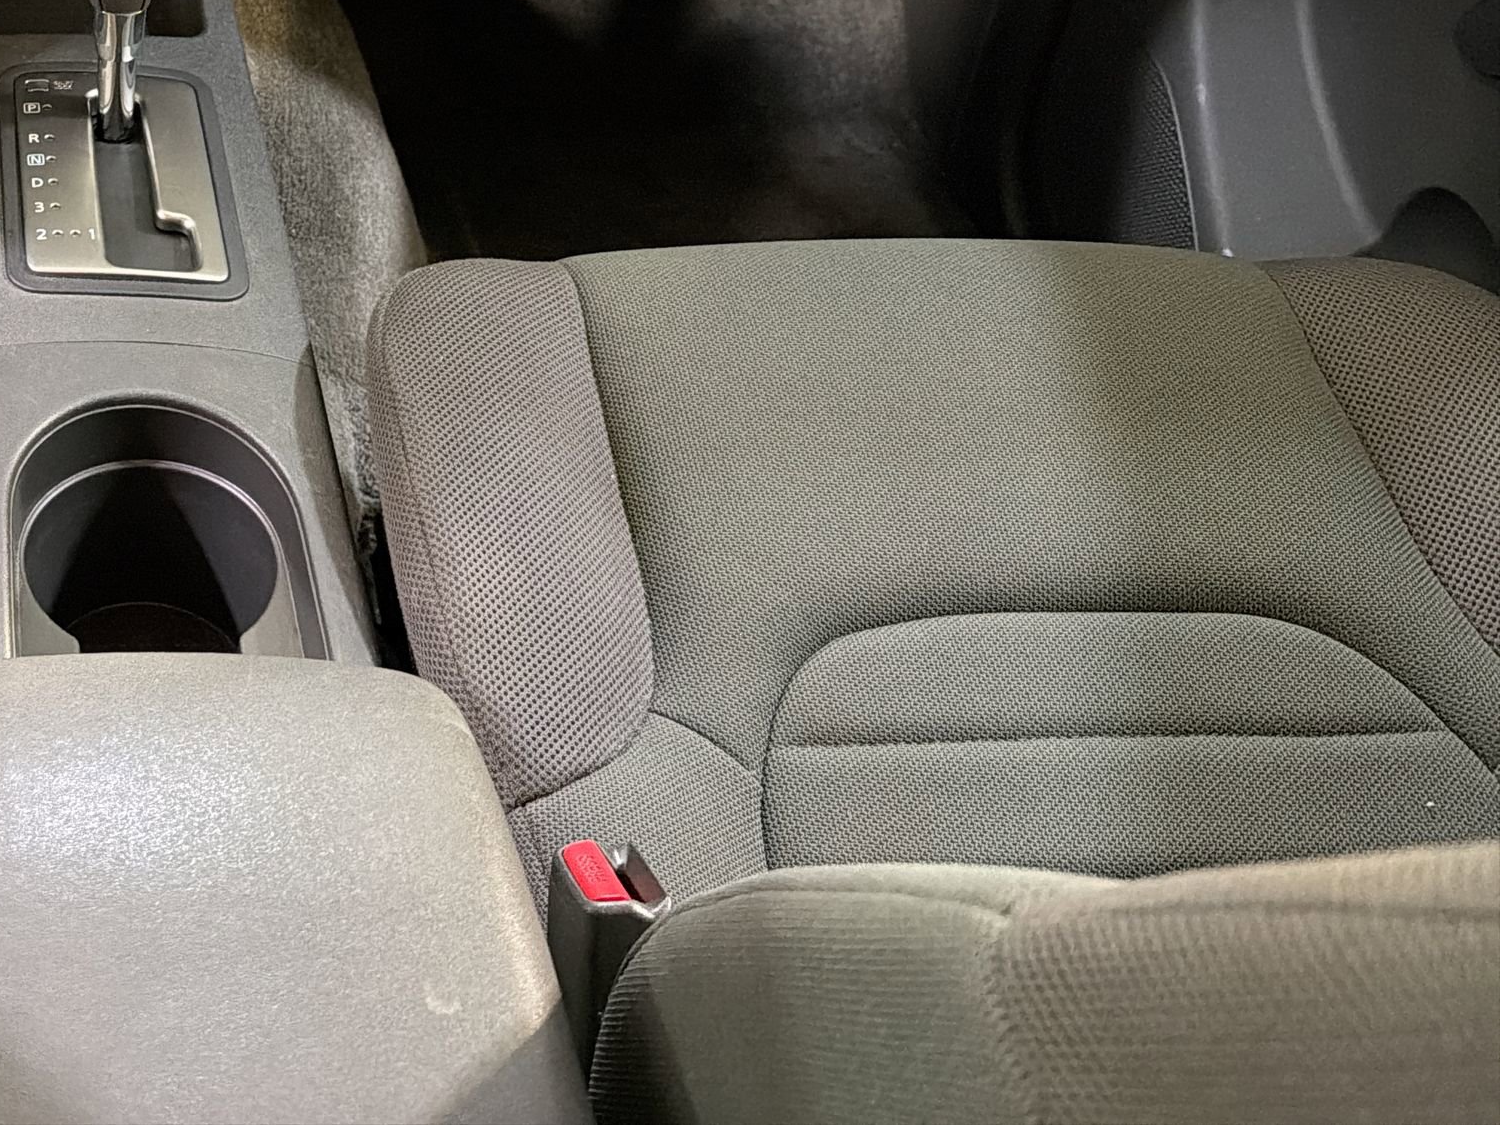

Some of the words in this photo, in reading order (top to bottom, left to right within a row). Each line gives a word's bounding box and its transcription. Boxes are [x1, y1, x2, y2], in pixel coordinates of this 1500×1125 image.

[27, 104, 37, 112] P
[28, 133, 40, 144] R
[31, 177, 44, 188] D
[34, 201, 45, 213] 3
[36, 228, 48, 241] 2
[88, 228, 96, 240] 1
